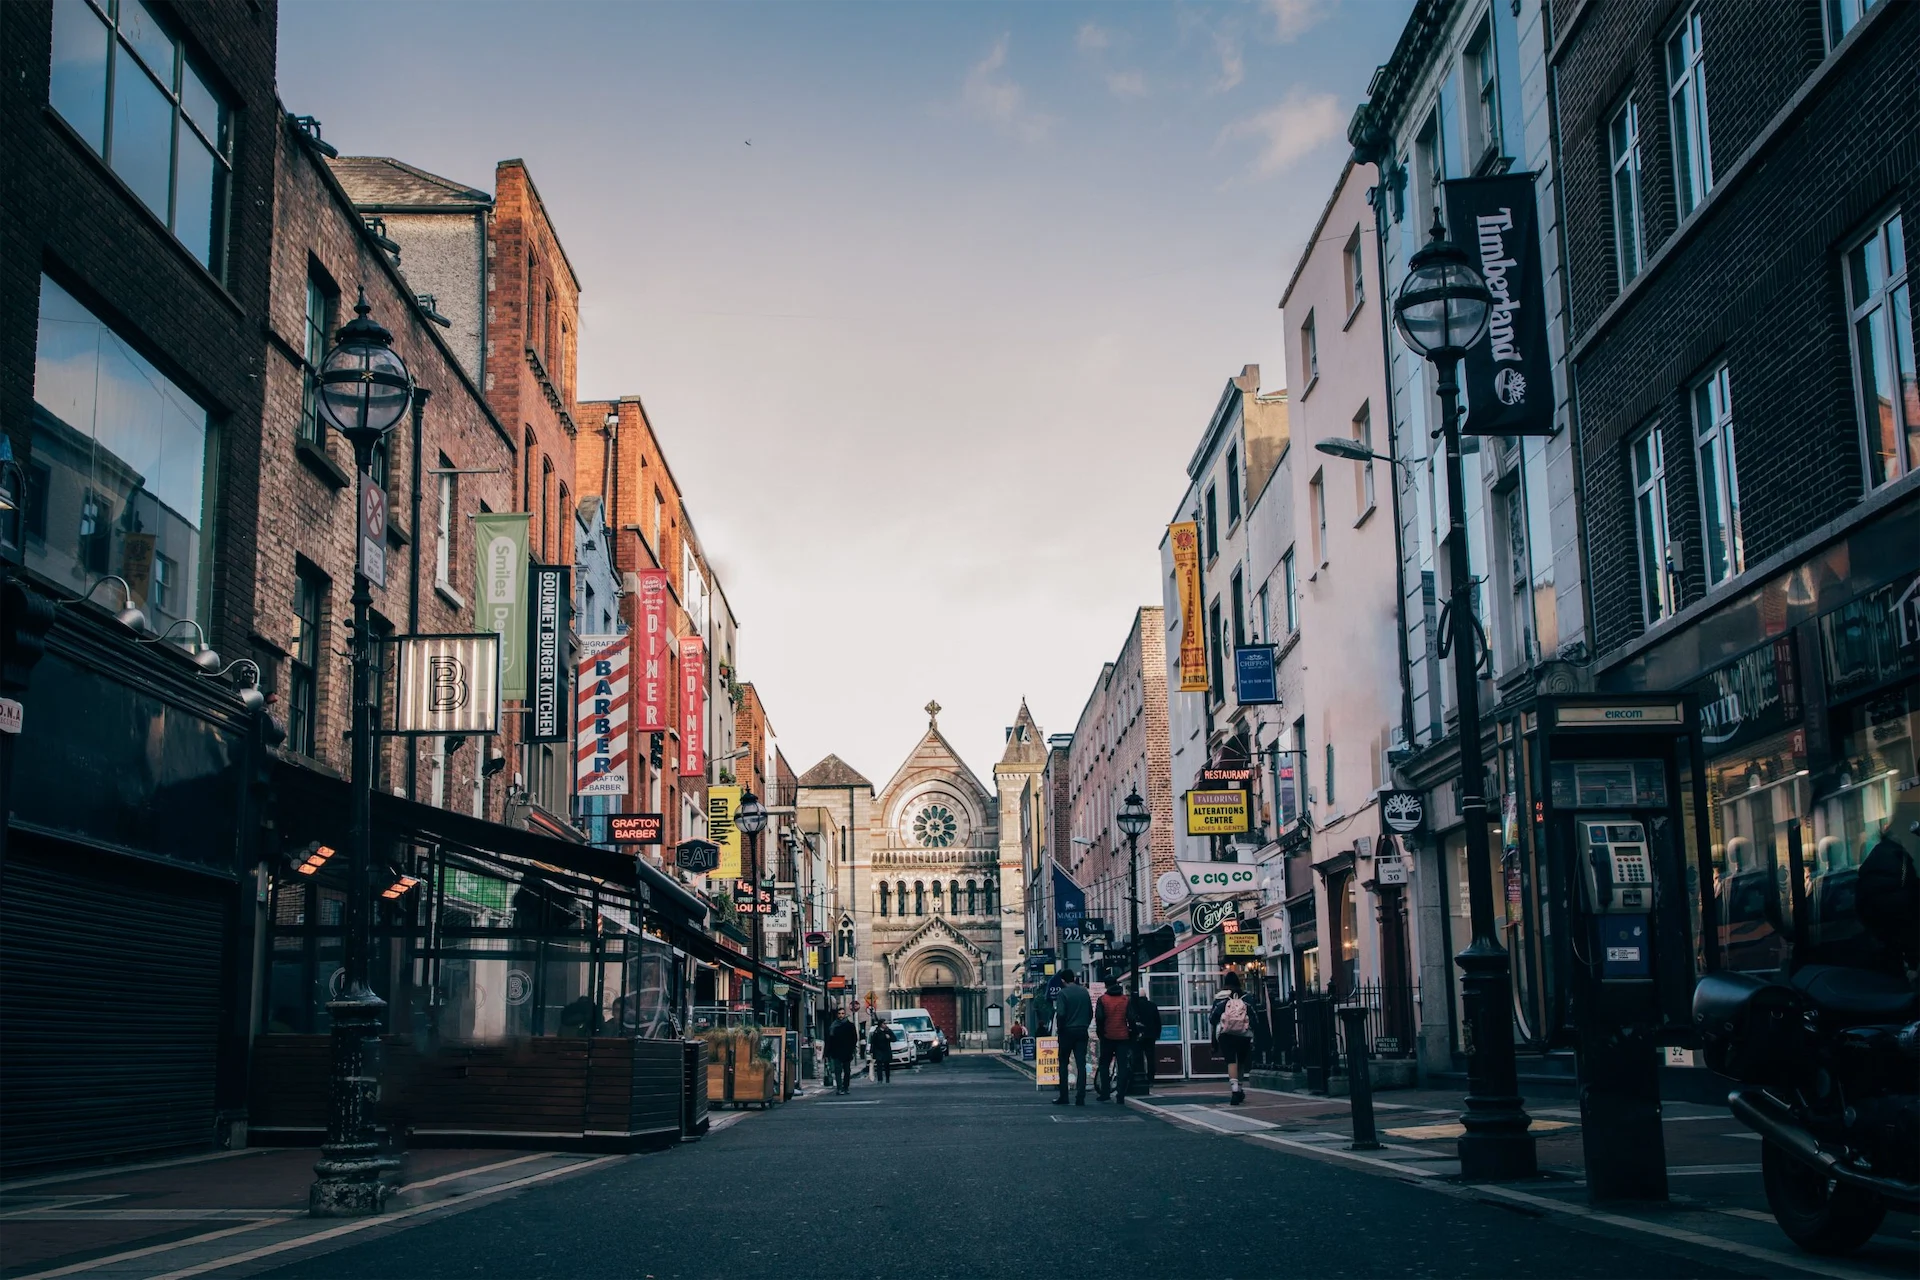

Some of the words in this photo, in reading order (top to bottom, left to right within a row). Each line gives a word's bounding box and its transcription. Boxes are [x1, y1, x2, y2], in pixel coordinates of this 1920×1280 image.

[1476, 207, 1523, 362] Timberland
[495, 545, 512, 597] Smiles
[541, 571, 556, 629] GOURMET
[540, 632, 554, 680] BURGER
[646, 614, 658, 725] DINER
[429, 656, 469, 711] B
[538, 681, 554, 736] KITCHEN
[594, 660, 612, 773] BARBER
[686, 675, 697, 771] DINER
[1204, 770, 1250, 779] RESTAURANT
[1193, 806, 1245, 815] ALTERATIONS
[1197, 795, 1239, 803] TAILORING
[612, 818, 660, 828] GRAFTON
[1204, 816, 1233, 824] CENTRE
[615, 829, 656, 838] BARBER
[679, 847, 716, 867] EAT
[1190, 874, 1200, 885] e
[1203, 872, 1229, 886] cig
[1232, 870, 1253, 882] co
[1192, 901, 1237, 934] Cave
[1224, 925, 1239, 933] BAR
[1064, 927, 1080, 941] 22
